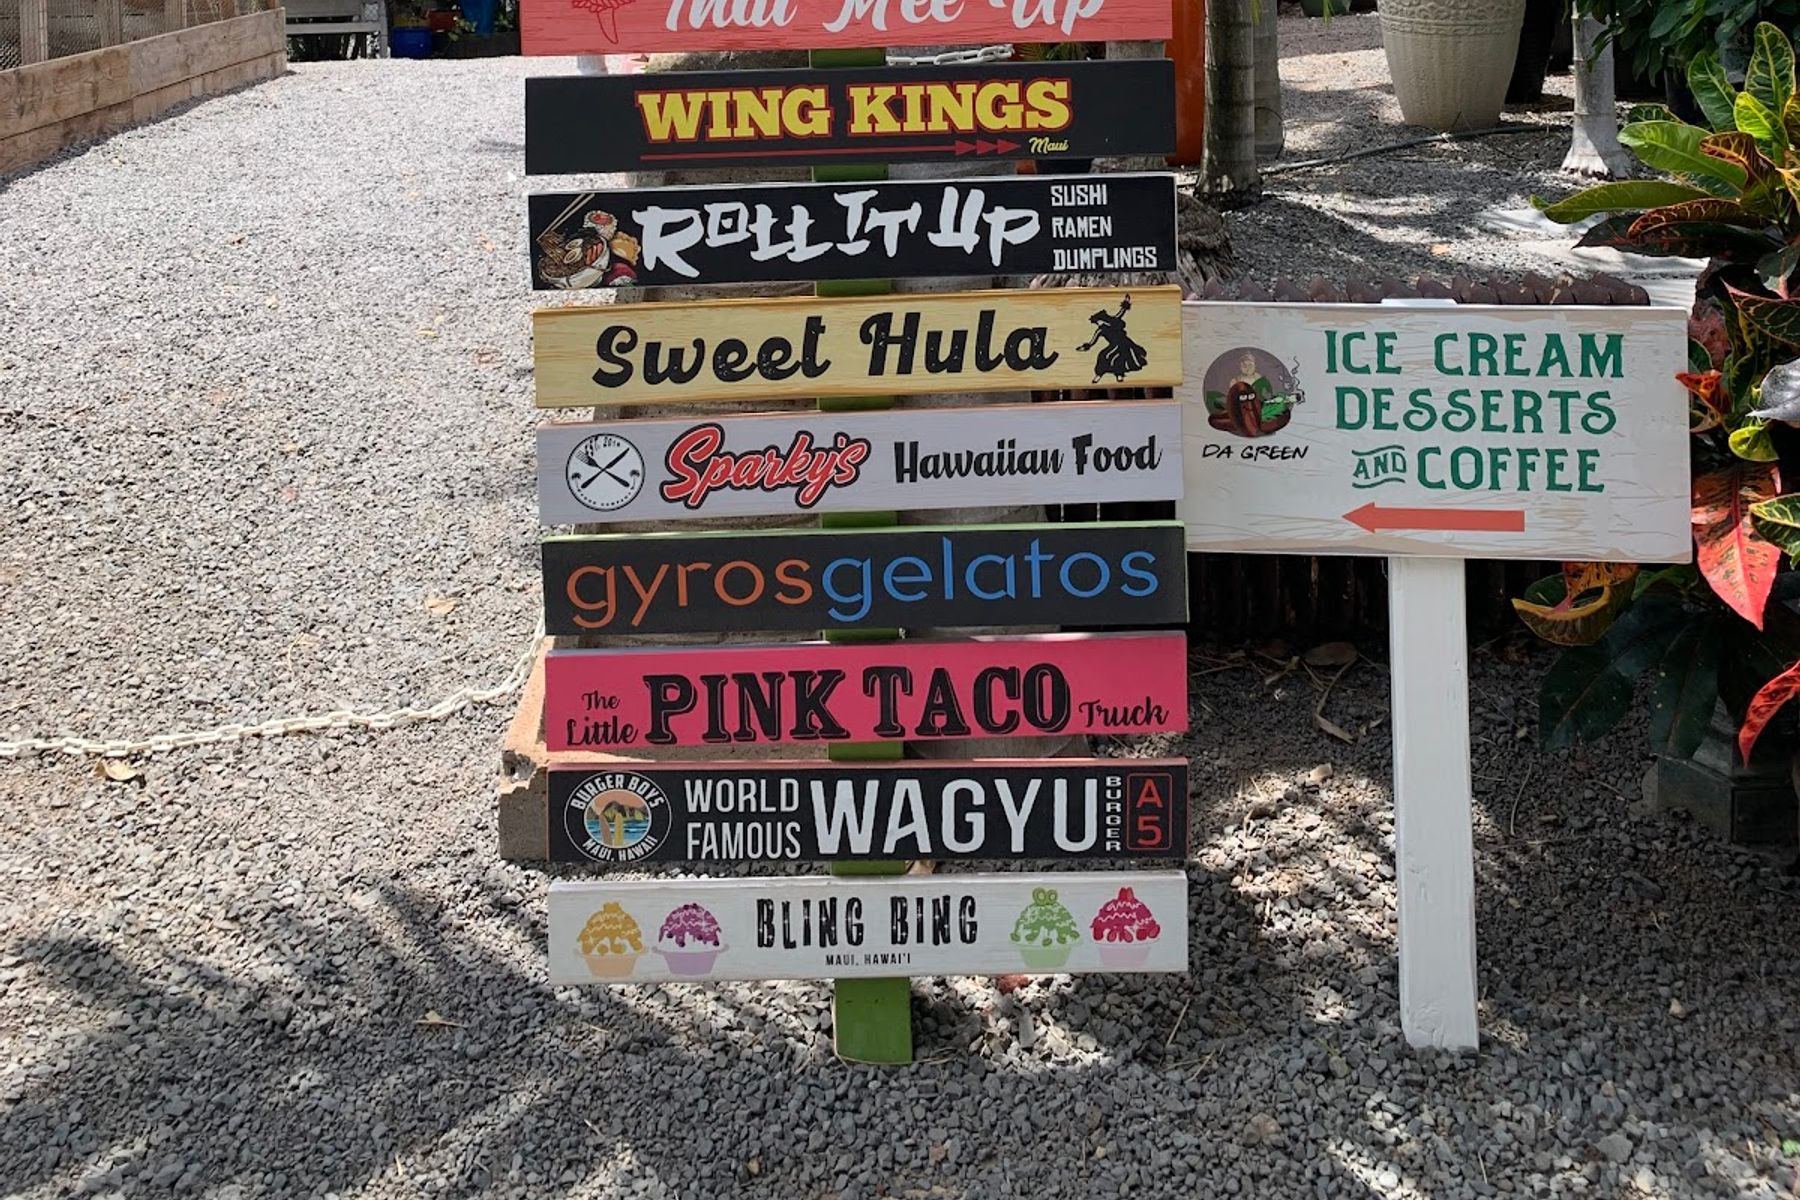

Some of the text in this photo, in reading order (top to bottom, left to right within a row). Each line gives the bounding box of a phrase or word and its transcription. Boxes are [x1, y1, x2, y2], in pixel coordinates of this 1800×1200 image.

[635, 78, 1072, 144] WING KINGS
[1028, 135, 1069, 156] Maui
[1051, 185, 1107, 206] SUSHI
[1051, 217, 1112, 238] RAMEN
[1053, 246, 1157, 270] DUMPLINGS
[591, 310, 1058, 388] Sweet Hula
[1325, 330, 1624, 378] ICE CREAM
[1335, 386, 1617, 435] DESSERTS
[659, 422, 873, 509] Sparky's
[894, 438, 1064, 483] Hawaiian
[1071, 433, 1162, 474] Food
[1202, 444, 1309, 461] DA GREEN
[1352, 446, 1605, 493] AND COFFEE
[581, 690, 620, 712] The
[643, 662, 1071, 745] PINK TACO
[1078, 699, 1168, 729] Truck
[566, 715, 638, 747] Little
[570, 774, 664, 810] BURGER BOYS
[684, 777, 800, 814] WORLD
[809, 778, 1098, 854] WAGYU
[1105, 775, 1122, 852] BURGER
[618, 834, 659, 862] HAWAII
[686, 821, 800, 860] FAMOUS
[756, 894, 979, 949] BLING BING
